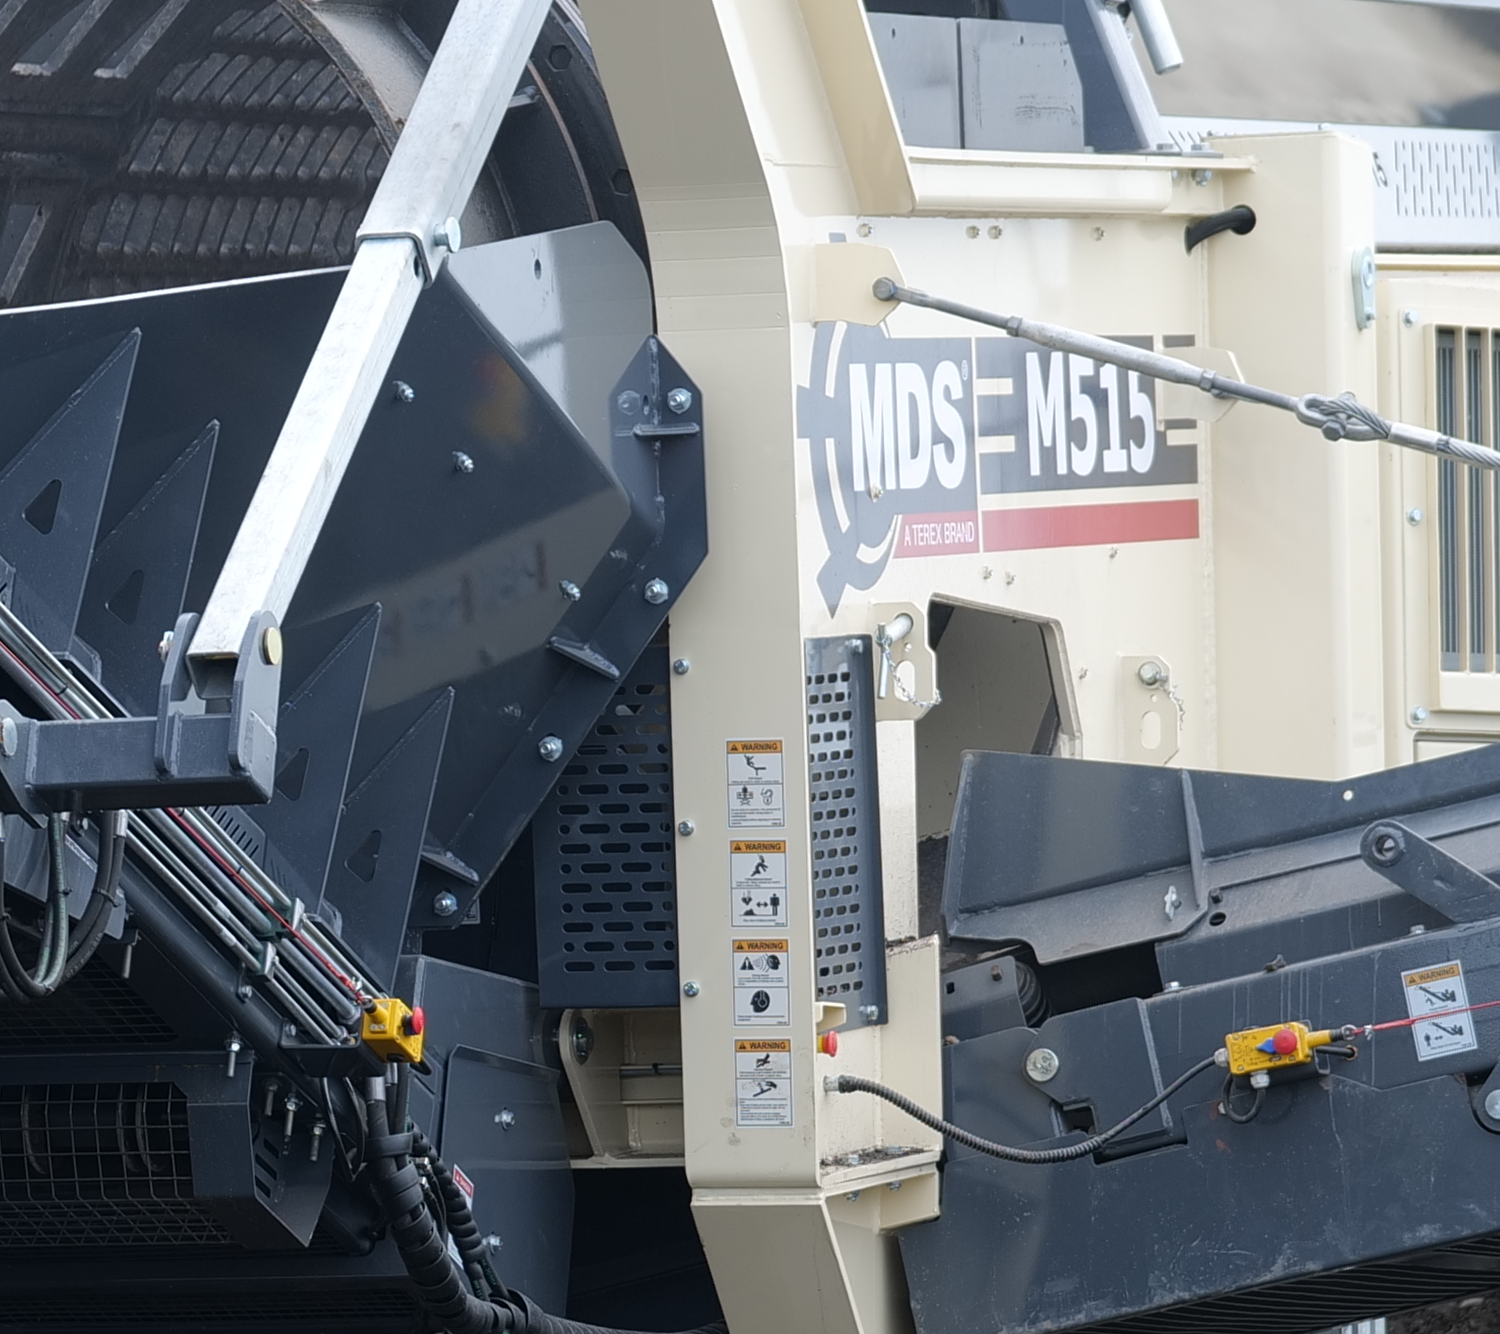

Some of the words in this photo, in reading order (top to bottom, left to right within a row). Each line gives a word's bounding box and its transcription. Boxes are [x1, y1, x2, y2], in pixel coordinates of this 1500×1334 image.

[1026, 351, 1155, 476] M515
[904, 525, 911, 546] A
[912, 523, 942, 546] TEREX
[944, 522, 975, 544] BRAND
[741, 742, 778, 751] WARNING
[744, 842, 781, 850] WARNING
[1419, 967, 1455, 981] WARNING
[750, 1041, 786, 1049] WARNING
